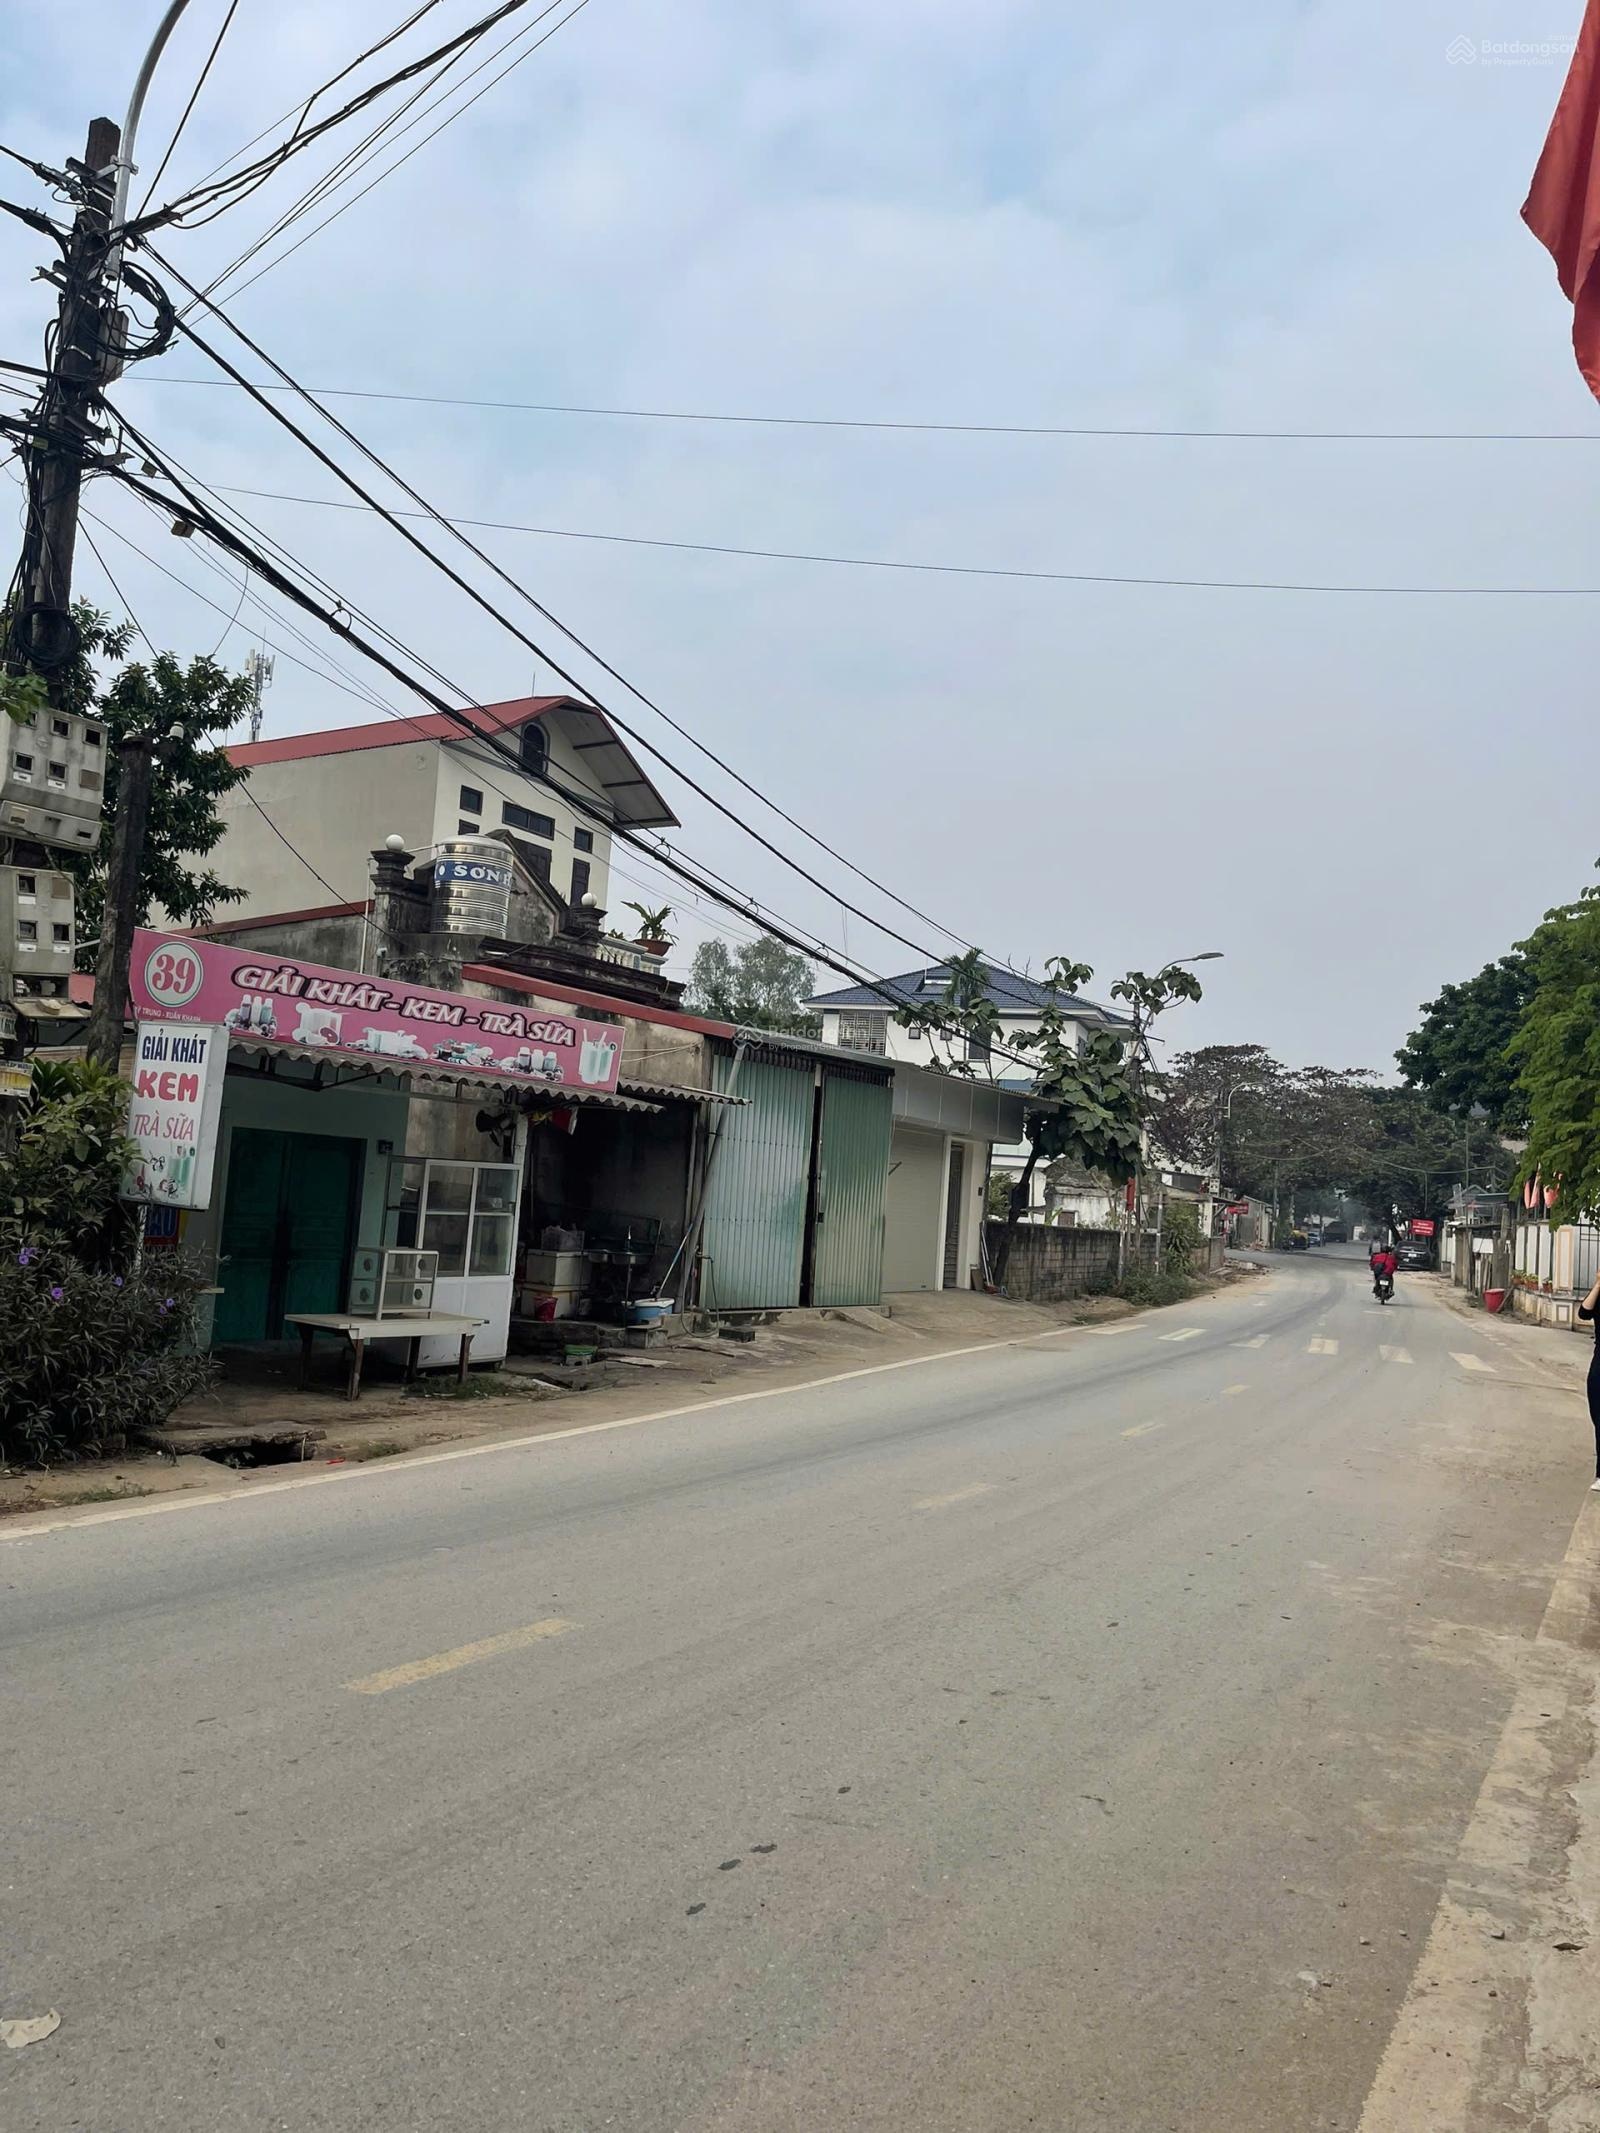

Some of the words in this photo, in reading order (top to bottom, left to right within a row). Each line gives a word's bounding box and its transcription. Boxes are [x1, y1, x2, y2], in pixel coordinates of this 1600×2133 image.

[152, 954, 196, 994] 39
[235, 966, 304, 996] GIẢI
[306, 979, 391, 1011] KHÁT
[403, 998, 464, 1026] KEM
[481, 1013, 526, 1037] TRÀ
[528, 1021, 575, 1046] SỮA
[142, 1028, 169, 1061] GIẢI
[171, 1033, 207, 1064] KHÁT
[138, 1069, 199, 1102] KEM
[133, 1109, 160, 1137] TRÀ
[163, 1112, 195, 1141] SỮA
